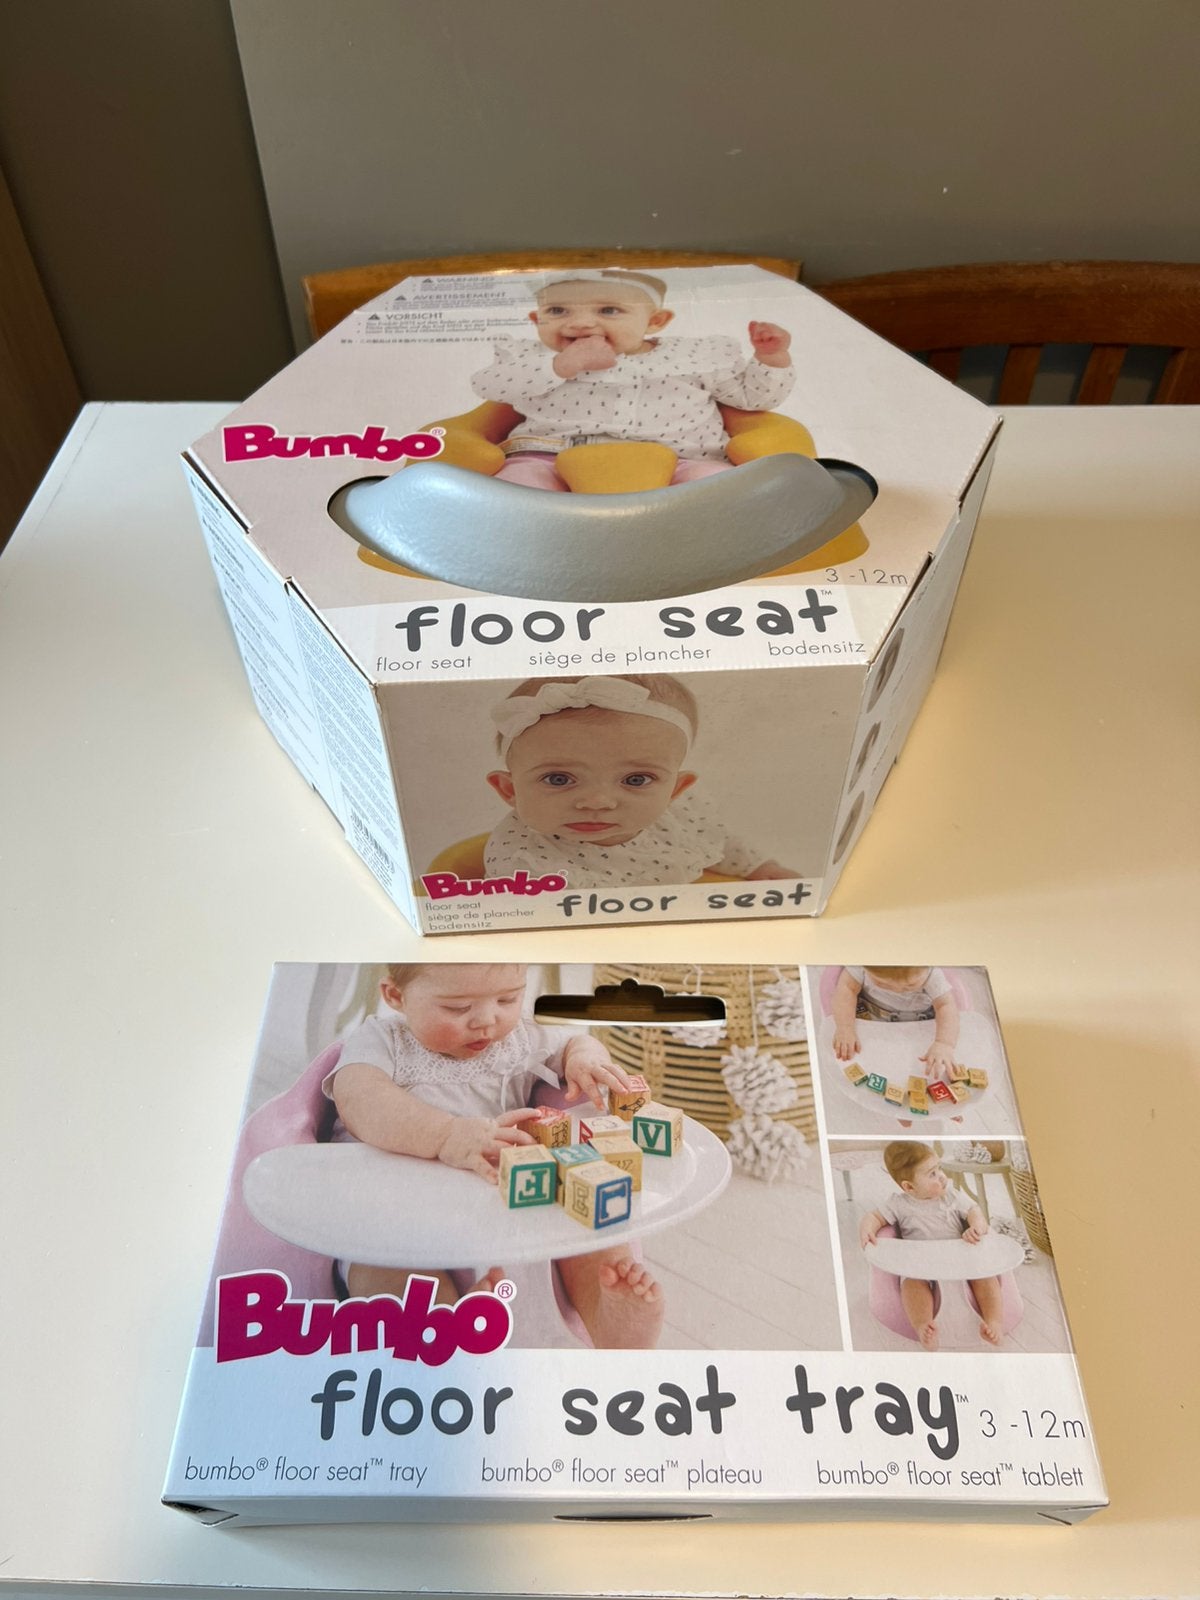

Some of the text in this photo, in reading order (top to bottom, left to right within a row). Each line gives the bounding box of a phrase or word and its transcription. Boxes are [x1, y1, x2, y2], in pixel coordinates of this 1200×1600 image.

[413, 292, 506, 300] AVERTISSEMENT
[386, 312, 443, 320] VORSICHT
[825, 568, 839, 583] 3
[394, 602, 605, 652] floor
[529, 646, 712, 668] siège de plancher
[768, 640, 866, 656] bodensitz
[376, 654, 472, 672] floor seat
[425, 902, 481, 911] floor seat
[428, 909, 535, 921] siège de plancher
[557, 893, 678, 917] floor
[429, 922, 492, 931] bodensitz
[639, 1122, 663, 1148] V
[311, 1368, 514, 1441] floor
[562, 1364, 736, 1436] seat
[980, 1410, 997, 1438] 3
[274, 1458, 320, 1482] floor
[389, 1462, 428, 1489] tray
[571, 1459, 616, 1483] floor
[687, 1463, 762, 1491] plateau
[907, 1461, 952, 1486] floor
[1022, 1463, 1084, 1487] tablett
